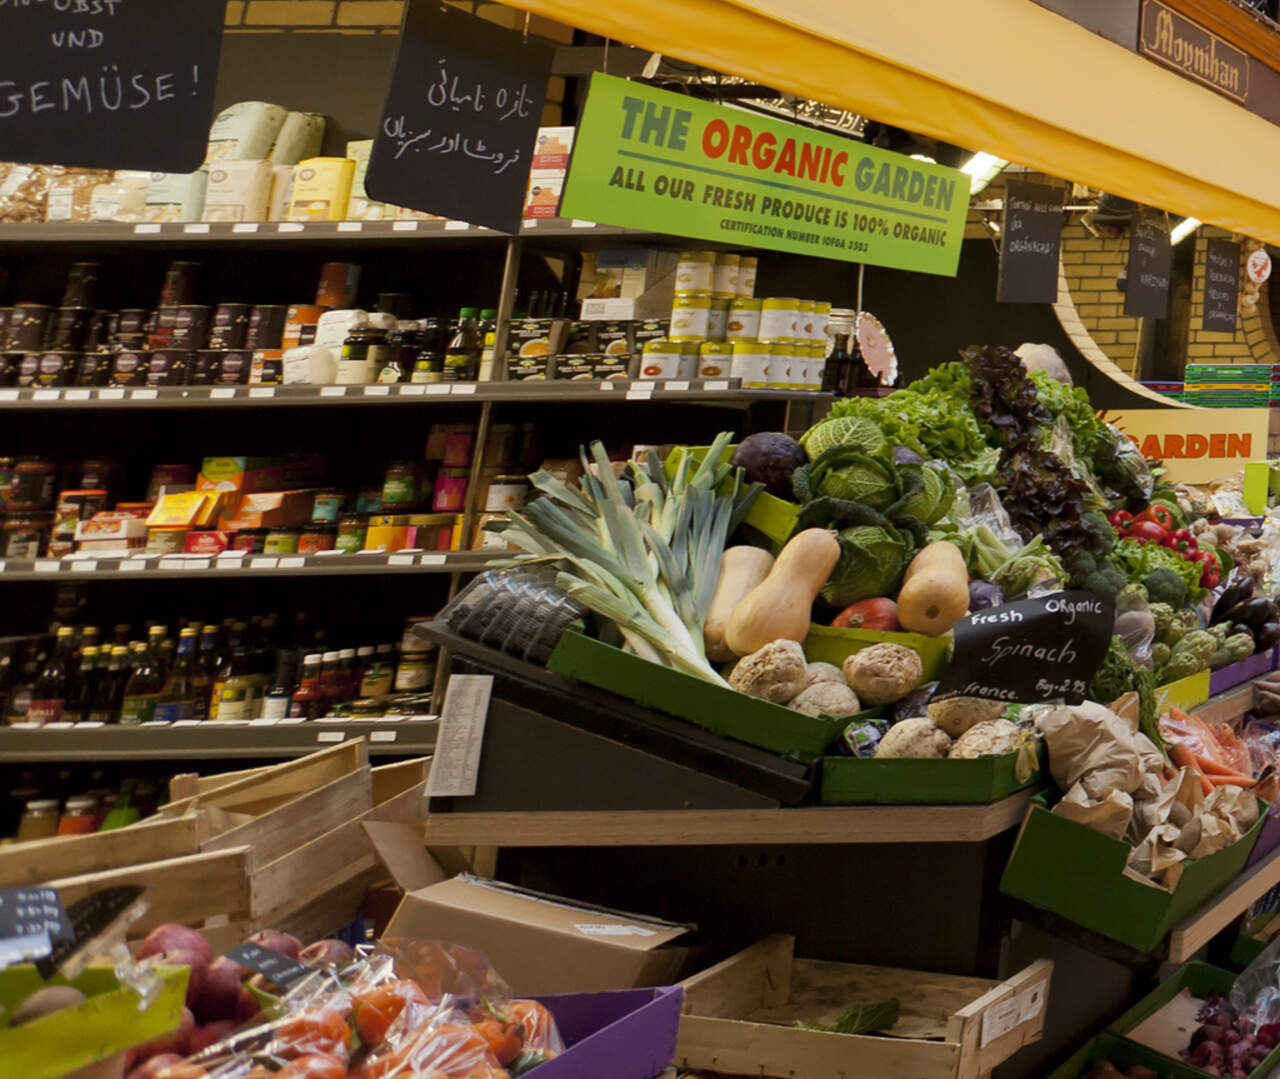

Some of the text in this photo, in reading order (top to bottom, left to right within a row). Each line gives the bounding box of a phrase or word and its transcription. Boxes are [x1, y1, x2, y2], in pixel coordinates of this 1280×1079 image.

[52, 28, 104, 49] UND
[1150, 10, 1241, 92] Moynihan
[621, 96, 956, 211] THE ORGANIC GARDEN
[609, 166, 947, 247] ALL OUR FRESH PRODUCE IS 100% ORGANIC
[720, 219, 783, 238] CERTIFICATION
[786, 229, 820, 244] NUMBER
[980, 636, 1076, 666] Spinach
